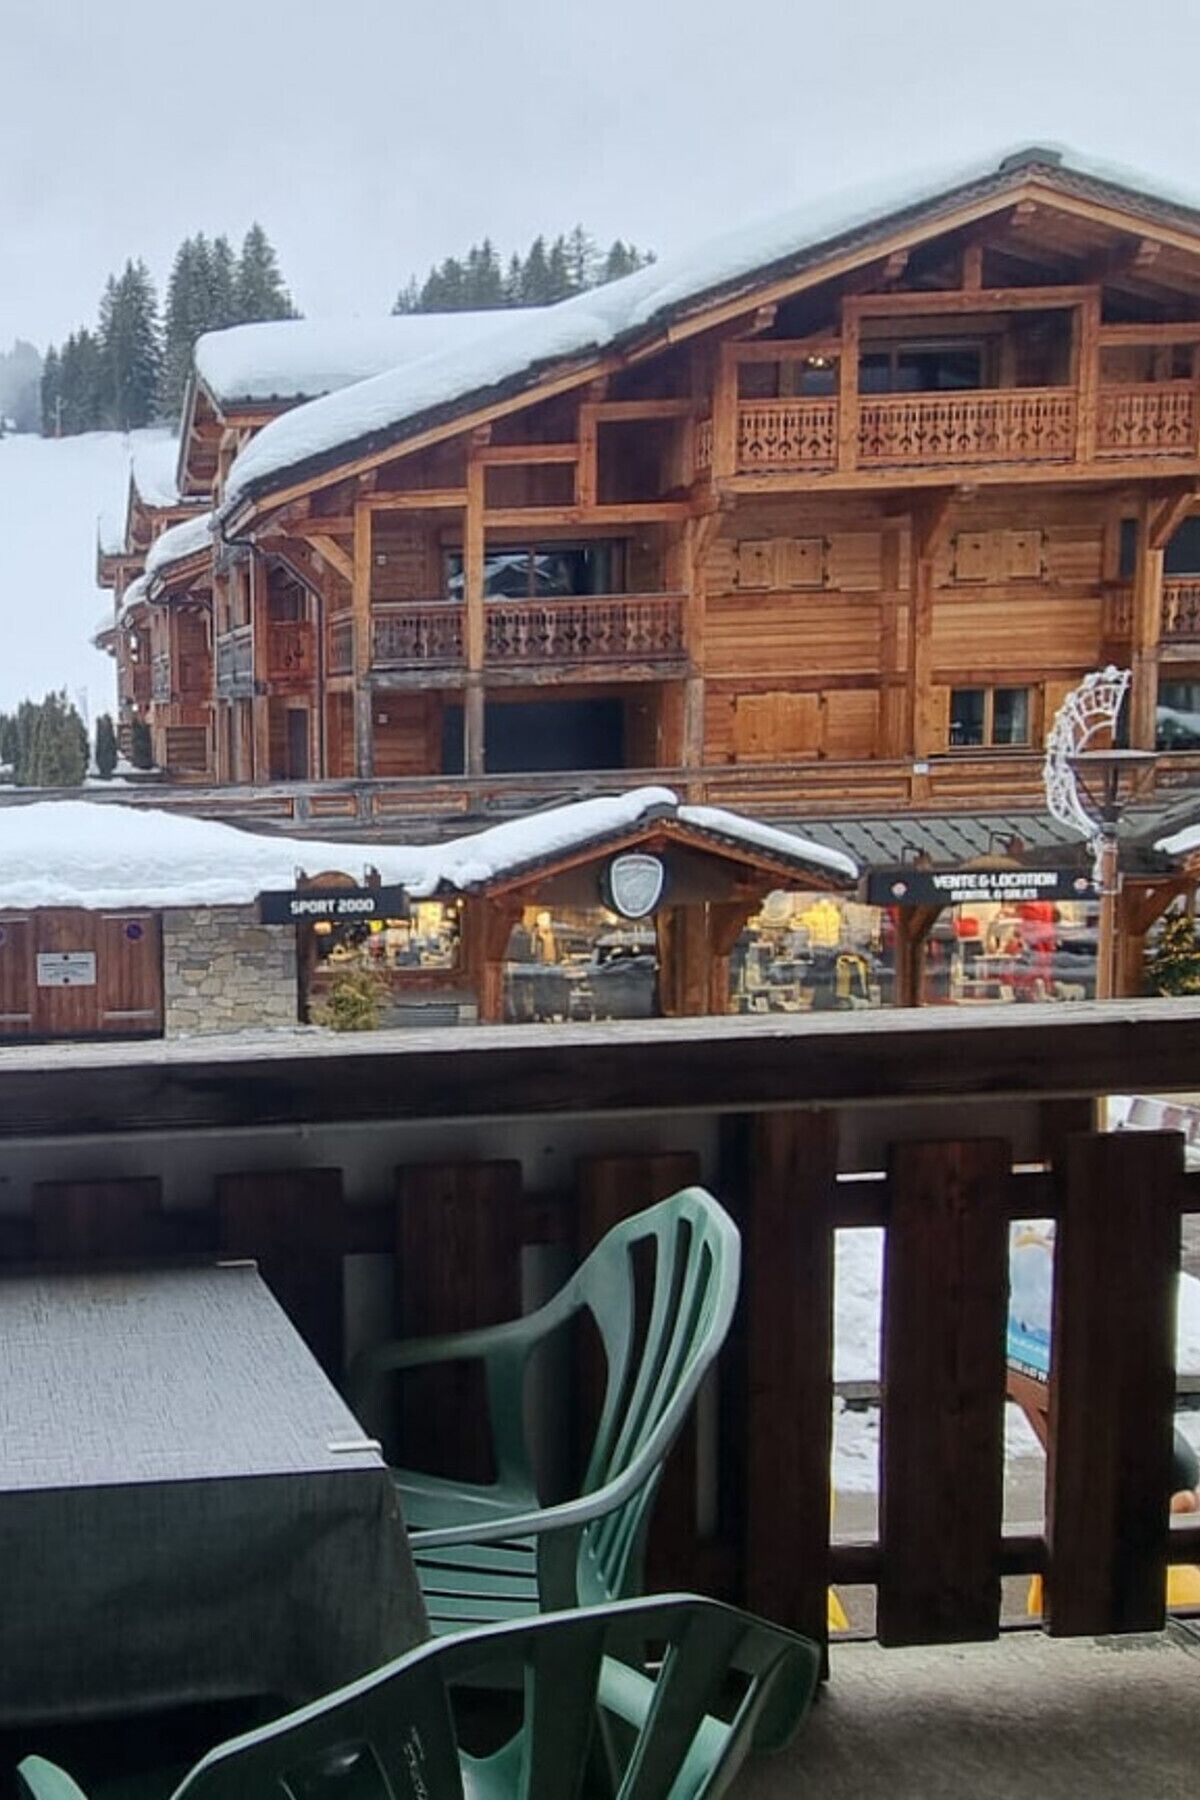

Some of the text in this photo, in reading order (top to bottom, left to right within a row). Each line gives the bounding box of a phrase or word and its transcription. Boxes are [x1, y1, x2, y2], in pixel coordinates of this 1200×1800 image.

[932, 874, 977, 889] VENTE
[990, 872, 1058, 888] LOCATION
[290, 898, 376, 915] SPORT 2000
